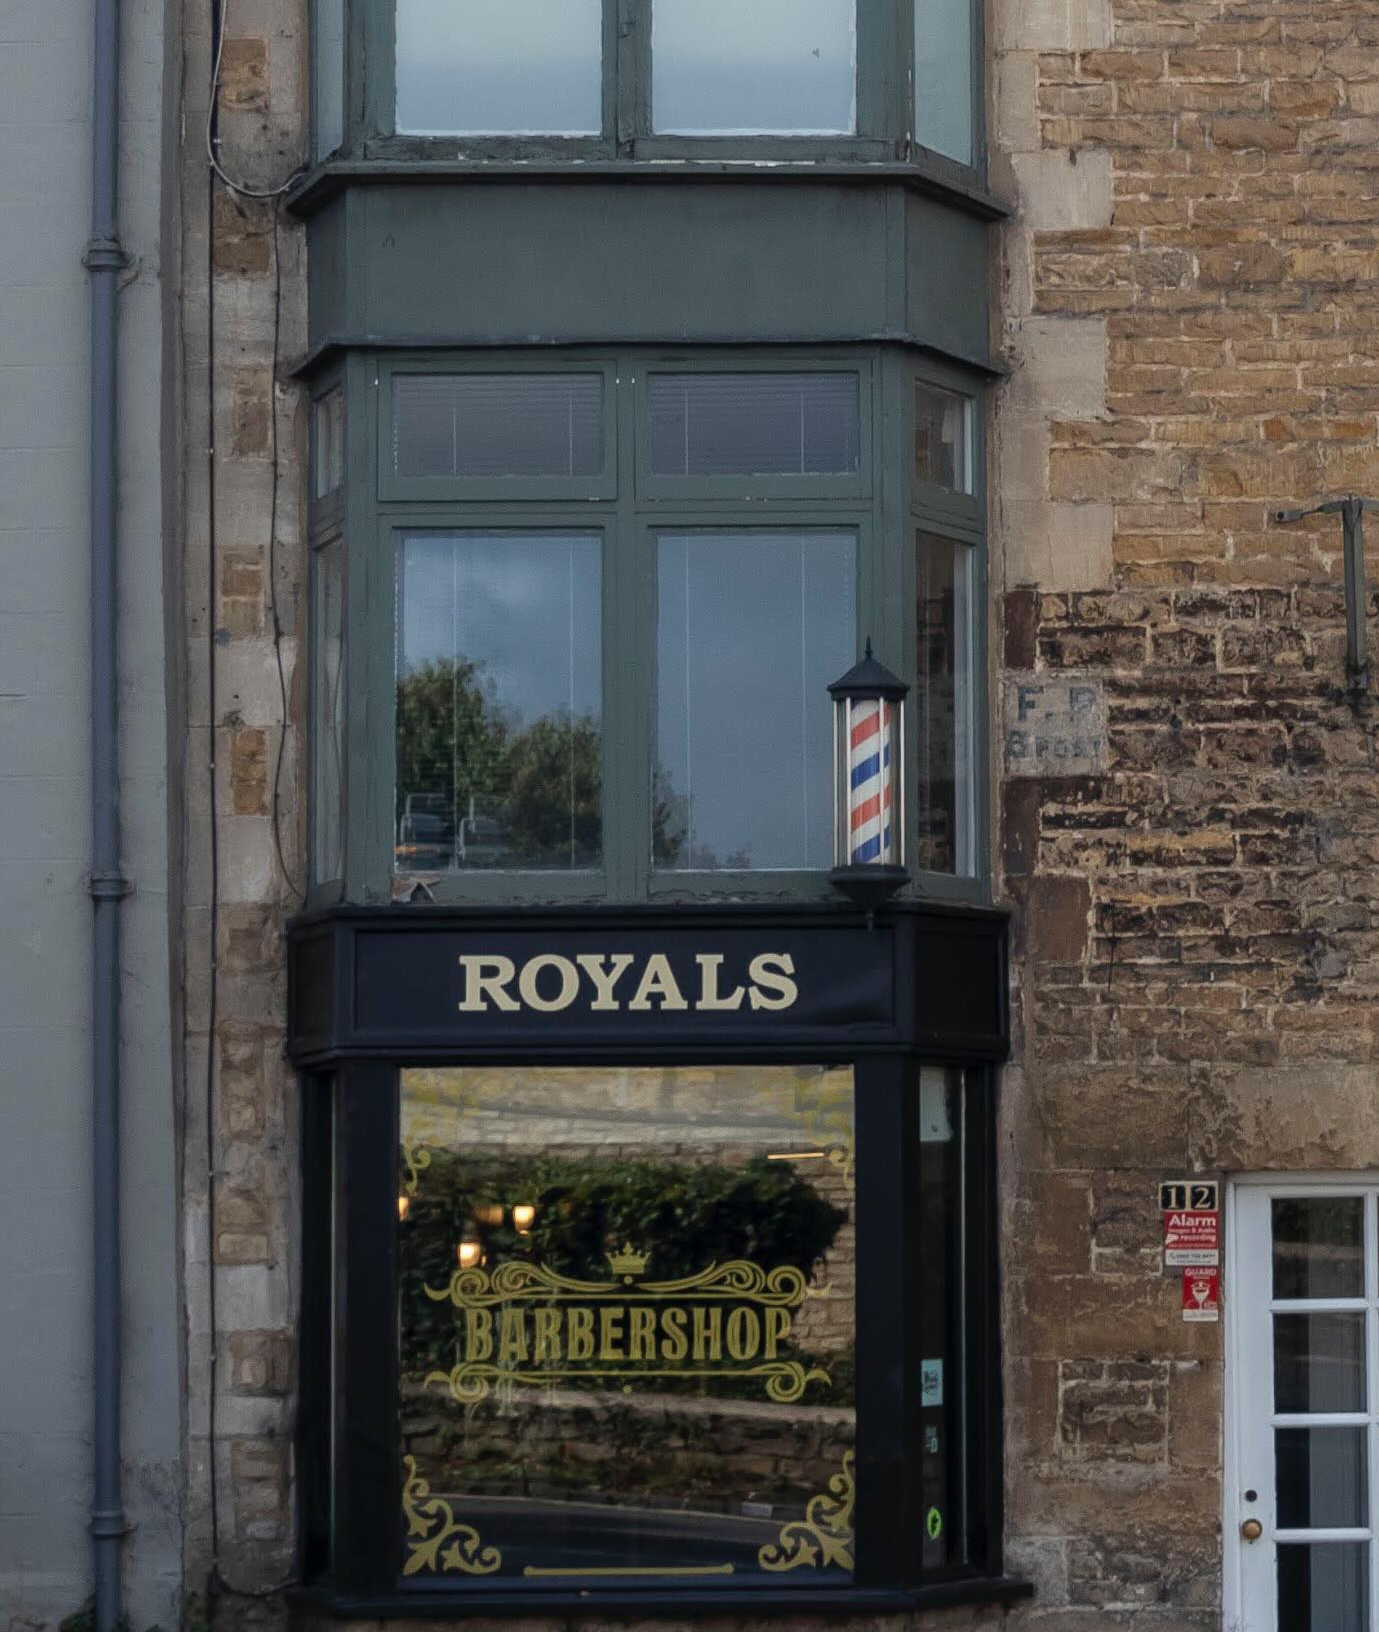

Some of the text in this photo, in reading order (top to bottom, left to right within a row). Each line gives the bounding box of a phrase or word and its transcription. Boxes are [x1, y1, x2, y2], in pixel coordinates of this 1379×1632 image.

[459, 953, 798, 1012] ROYALS
[1167, 1187, 1212, 1209] 12
[1169, 1213, 1217, 1227] Alarm
[465, 1307, 792, 1361] BARBERSHOP
